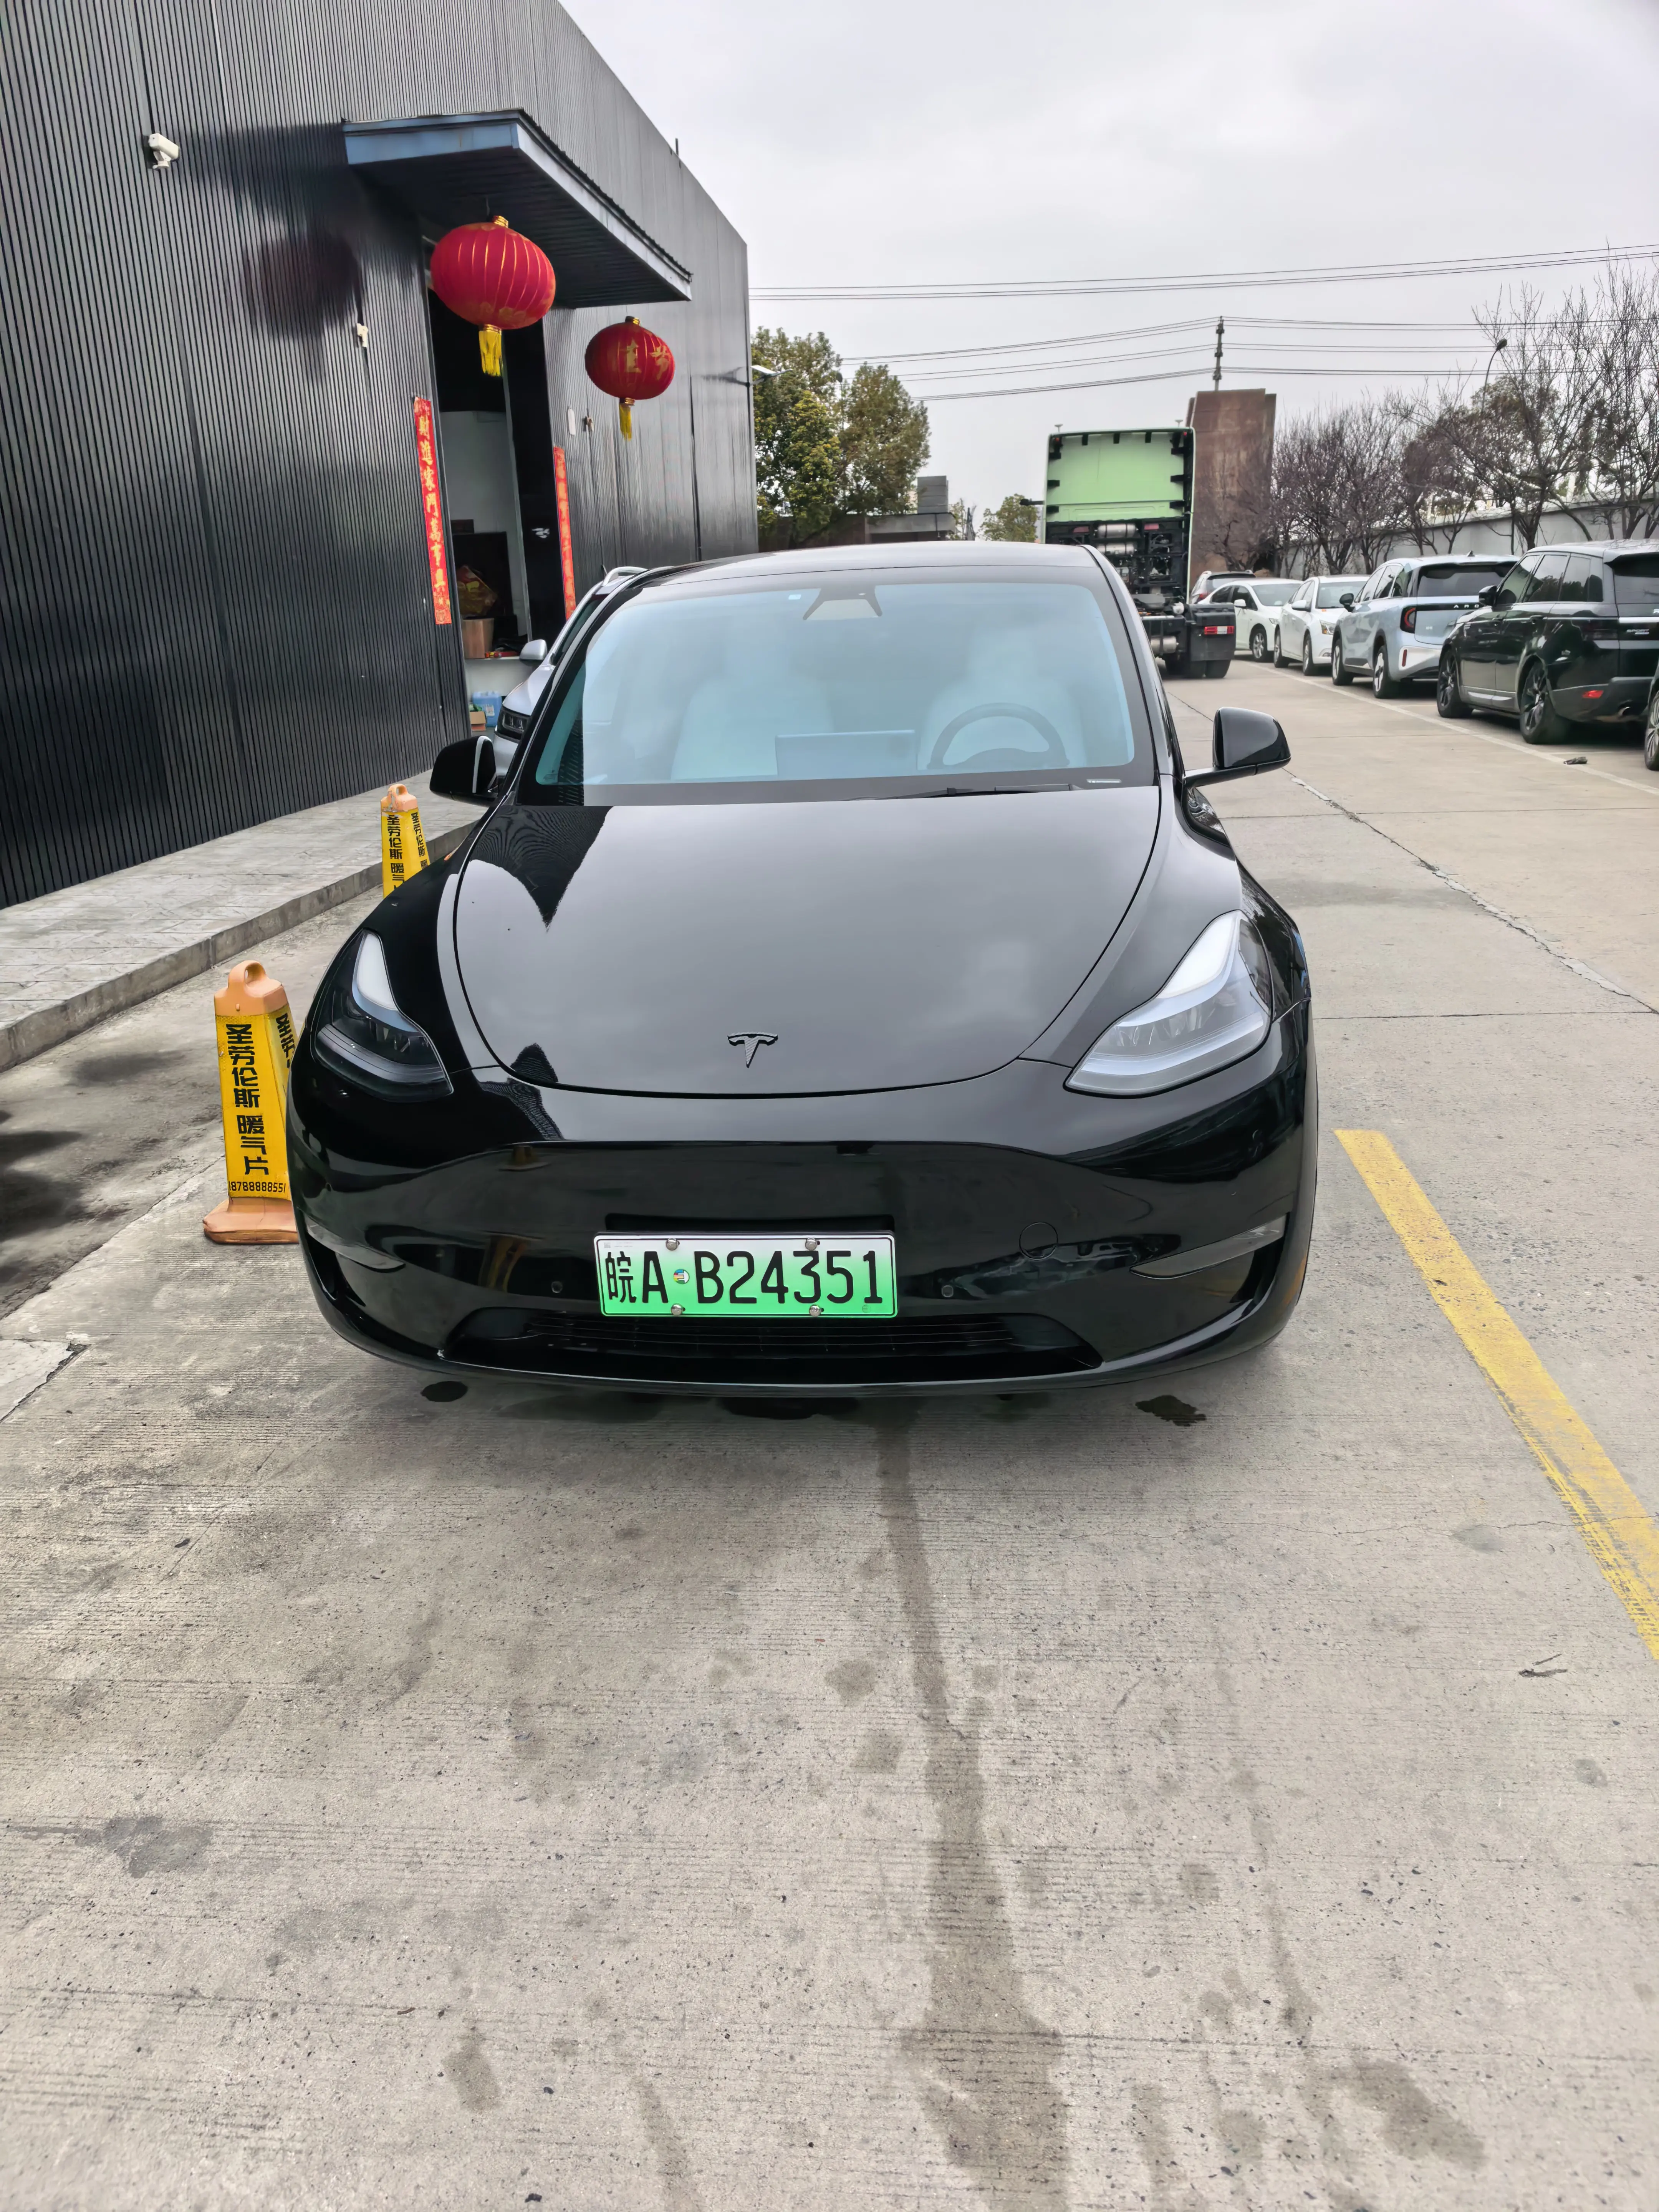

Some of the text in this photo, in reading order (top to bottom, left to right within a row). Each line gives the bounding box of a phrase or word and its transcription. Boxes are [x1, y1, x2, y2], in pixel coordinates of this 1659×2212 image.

[390, 863, 405, 890] 暖气
[226, 1024, 269, 1175] 圣劳伦斯 暖气片
